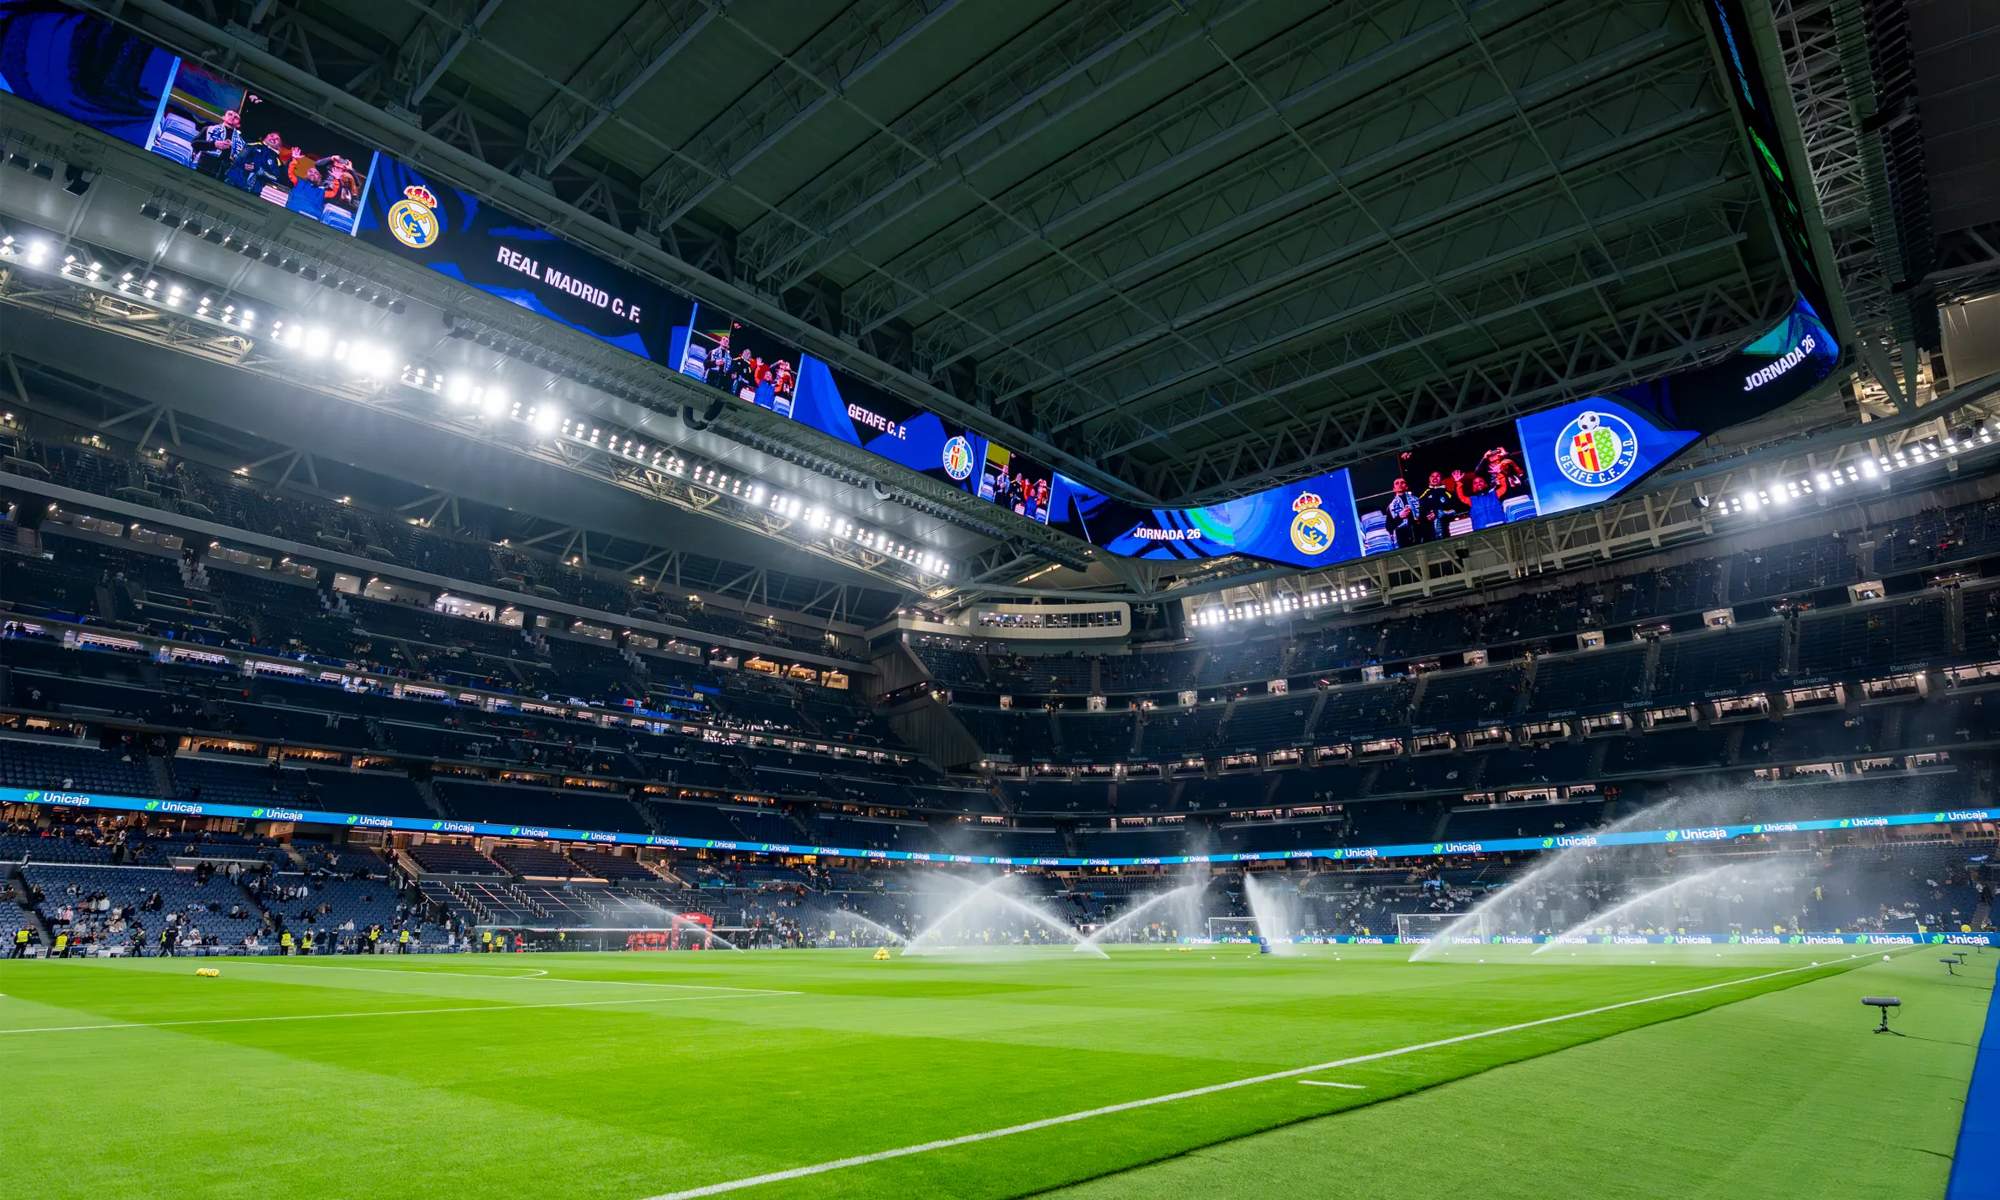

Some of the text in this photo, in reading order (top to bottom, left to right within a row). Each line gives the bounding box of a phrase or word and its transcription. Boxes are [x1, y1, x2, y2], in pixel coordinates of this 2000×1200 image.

[496, 246, 641, 324] REAL MADRID C. F.
[1743, 334, 1816, 391] JORNADA 26
[848, 403, 907, 440] GETAFE C. F.
[1560, 455, 1593, 483] GETAFE
[1133, 527, 1201, 541] JORNADA 26
[43, 792, 90, 807] Unicaja
[161, 801, 203, 815] Unicaja
[266, 808, 304, 822] Unicaja
[1947, 810, 1988, 821] Unicaja
[359, 816, 393, 829] Unicaja
[1764, 822, 1798, 832] Unicaja
[1851, 817, 1888, 827] Unicaja
[444, 822, 475, 834] Unicaja
[521, 827, 549, 838] Unicaja
[590, 832, 617, 843] Unicaja
[1680, 828, 1727, 841] Unicaja
[655, 836, 679, 847] Unicaja
[714, 840, 737, 850] Unicaja
[1556, 835, 1598, 848] Unicaja
[769, 844, 790, 853] Unicaja
[820, 847, 840, 856] Unicaja
[1345, 847, 1378, 859] Unicaja
[1445, 842, 1482, 853] Unicaja
[868, 850, 887, 859] Unicaja
[912, 852, 931, 861] Unicaja
[1189, 855, 1209, 863] Unicaja
[1240, 852, 1260, 861] Unicaja
[1291, 850, 1312, 858] Unicaja
[1039, 858, 1059, 867] Unicaja
[1089, 858, 1110, 867] Unicaja
[1140, 857, 1161, 866] Unicaja
[1946, 934, 1990, 946] Unicaja
